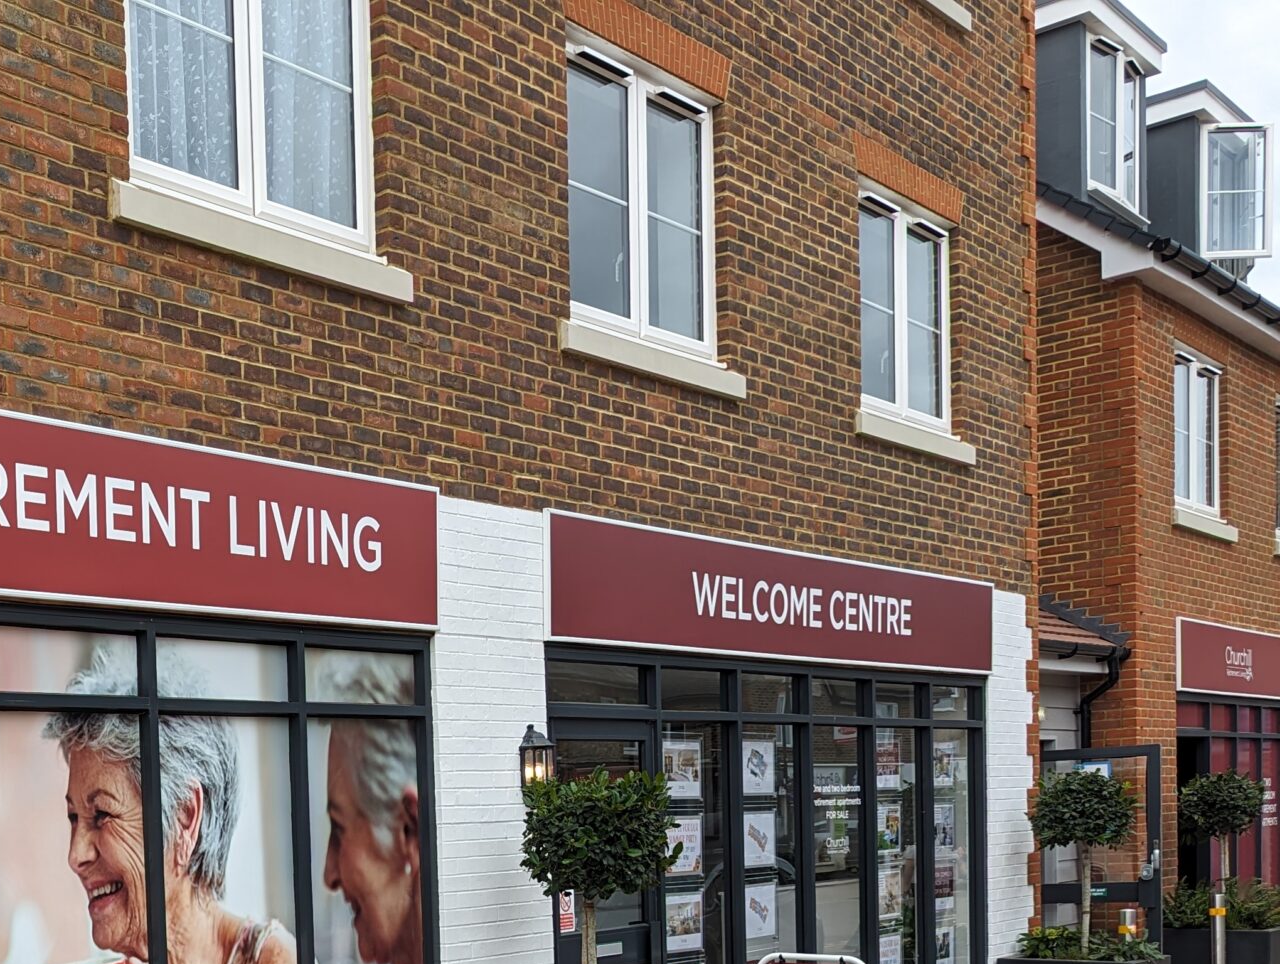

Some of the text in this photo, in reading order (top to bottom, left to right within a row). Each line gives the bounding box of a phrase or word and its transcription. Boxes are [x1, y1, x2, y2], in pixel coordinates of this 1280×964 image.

[228, 495, 382, 573] LIVING
[691, 571, 912, 636] WELCOME CENTRE
[825, 810, 849, 820] FOR SALE
